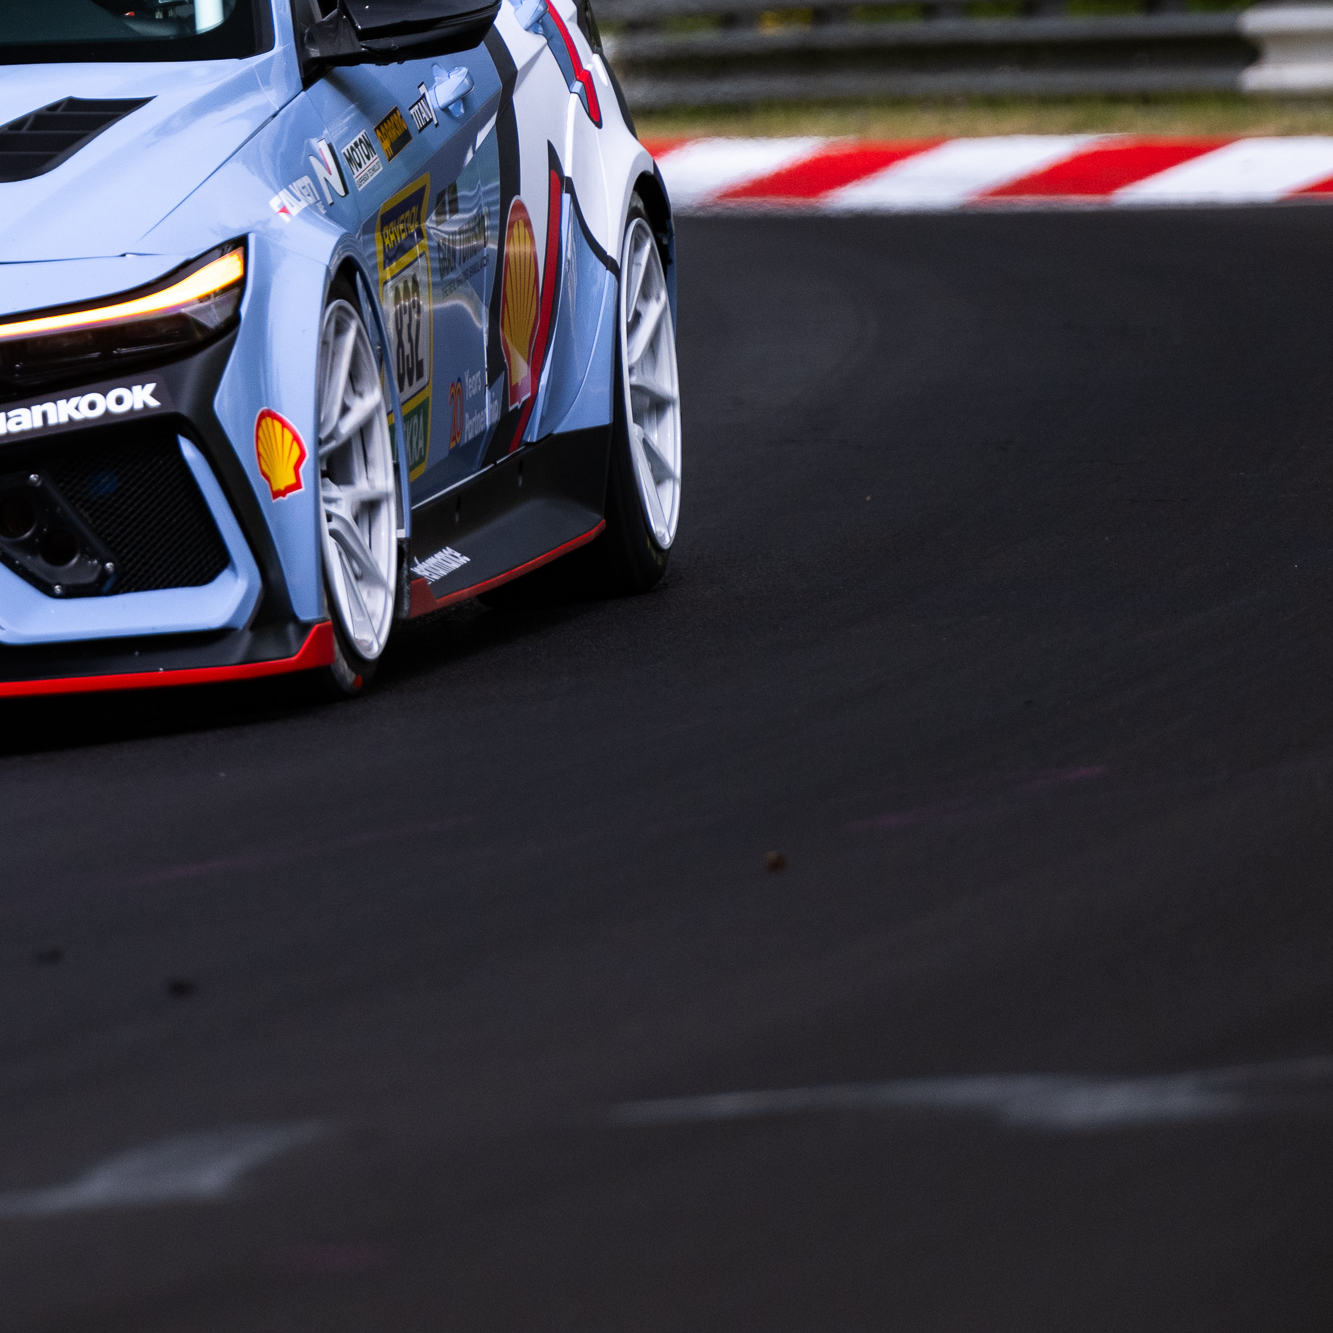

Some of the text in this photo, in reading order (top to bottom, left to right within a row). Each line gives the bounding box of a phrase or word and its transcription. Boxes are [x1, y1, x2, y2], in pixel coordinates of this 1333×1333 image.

[342, 131, 377, 176] MOTON
[382, 205, 420, 254] RAVENOL
[394, 272, 424, 393] 832
[448, 369, 481, 450] 20 Years
